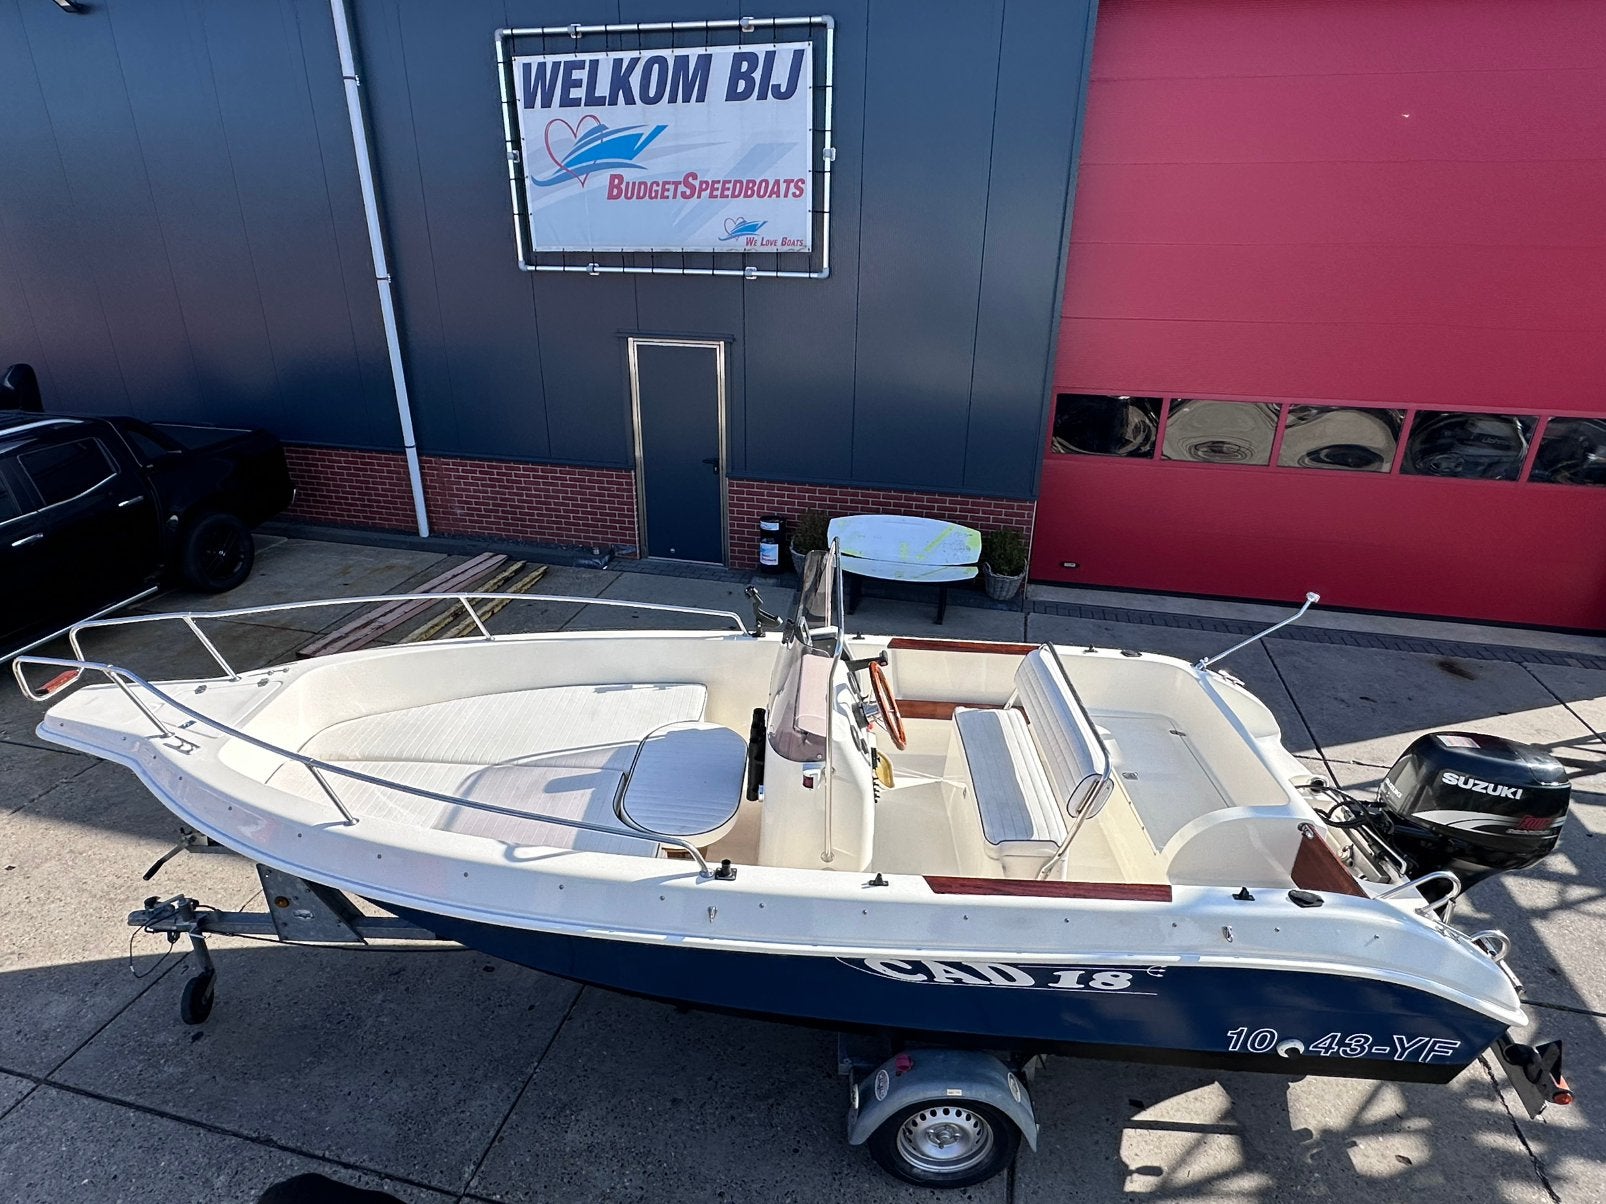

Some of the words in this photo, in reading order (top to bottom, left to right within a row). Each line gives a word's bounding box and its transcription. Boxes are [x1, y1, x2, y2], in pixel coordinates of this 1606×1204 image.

[522, 53, 713, 110] WELKOM
[725, 49, 805, 102] BIJ
[1441, 771, 1523, 800] SUZUKI
[1048, 969, 1135, 991] 18
